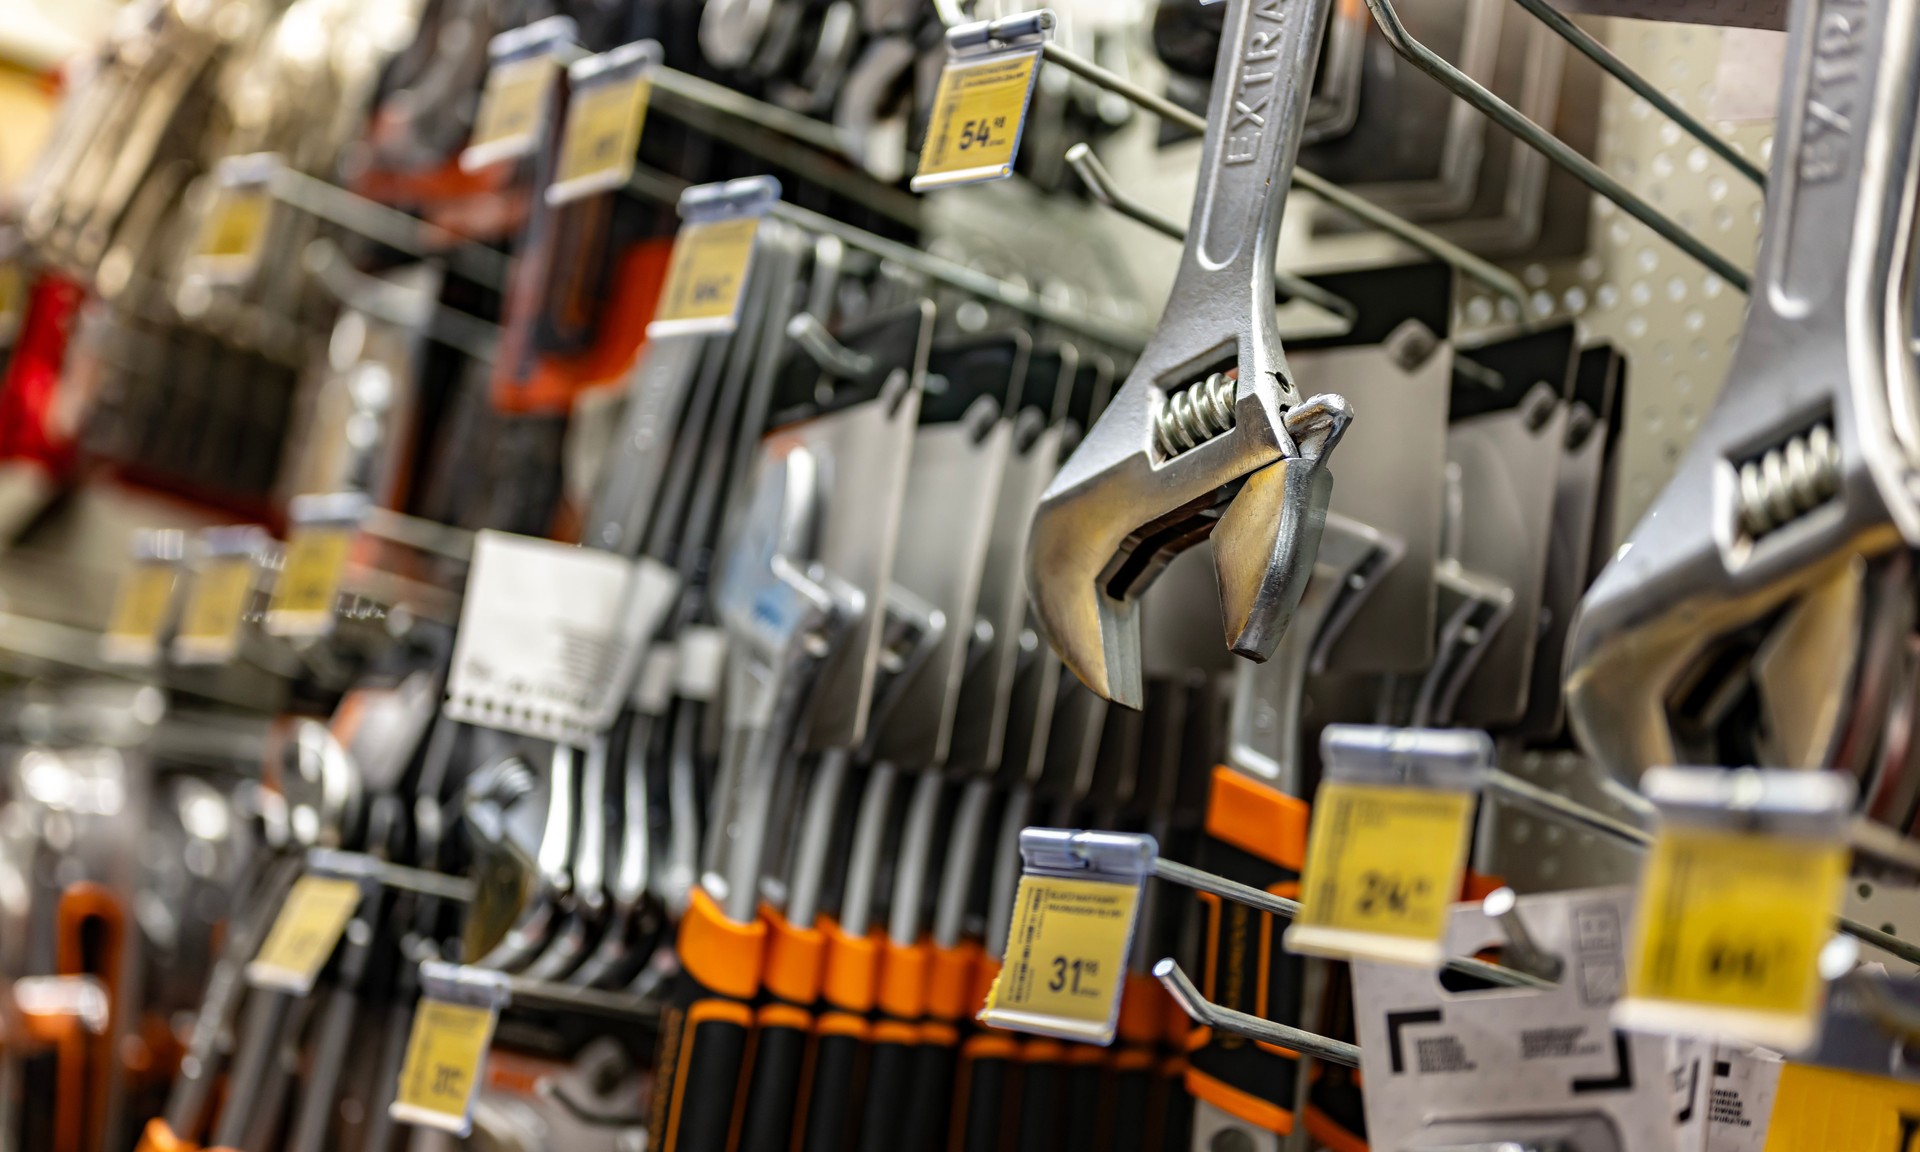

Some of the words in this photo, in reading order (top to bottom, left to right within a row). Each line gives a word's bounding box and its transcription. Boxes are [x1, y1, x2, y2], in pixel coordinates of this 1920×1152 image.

[1801, 0, 1866, 182] EXTR
[958, 119, 991, 150] 54
[1048, 956, 1082, 994] 31
